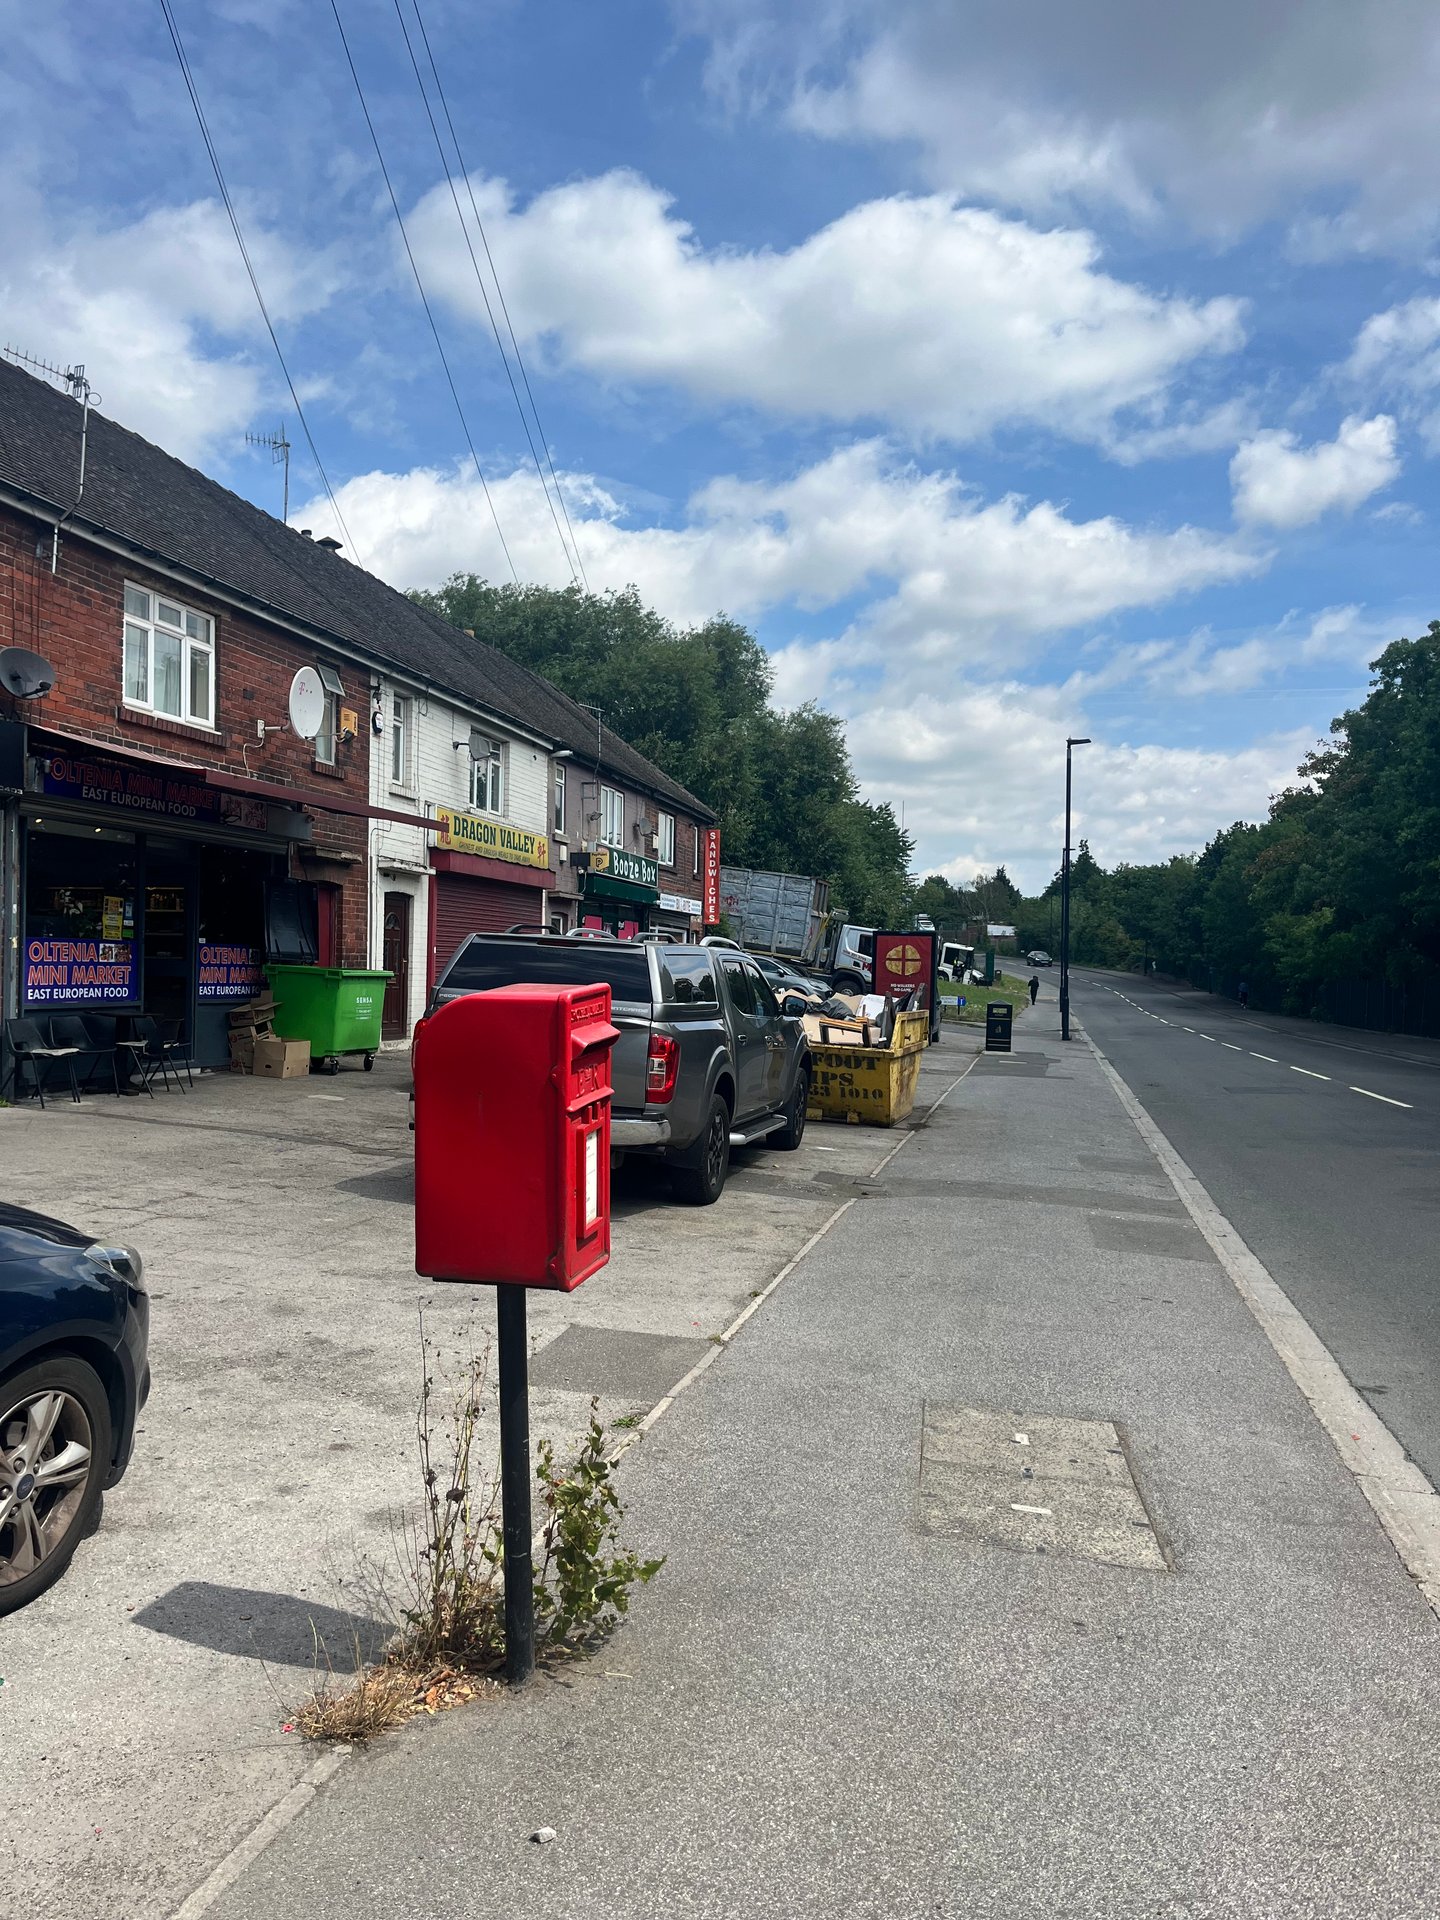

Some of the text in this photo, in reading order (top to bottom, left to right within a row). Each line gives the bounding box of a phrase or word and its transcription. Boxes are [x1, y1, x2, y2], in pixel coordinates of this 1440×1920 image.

[50, 757, 220, 809] OLTENIA MINI MARKET
[82, 785, 196, 817] EAST EUROPEAN FOOD
[454, 815, 535, 854] DRAGON VALLEY
[613, 852, 656, 882] Booze Box
[708, 832, 717, 922] SANDWICHES
[28, 941, 98, 962] OLTENIA
[200, 946, 248, 965] OLTENIA
[28, 965, 132, 986] MINI MARKET
[199, 966, 227, 984] MINI
[28, 987, 129, 1000] EAST EUROPEAN FOOD
[199, 986, 215, 996] EAST
[216, 986, 251, 995] EUROPEAN
[840, 1086, 884, 1100] 1010
